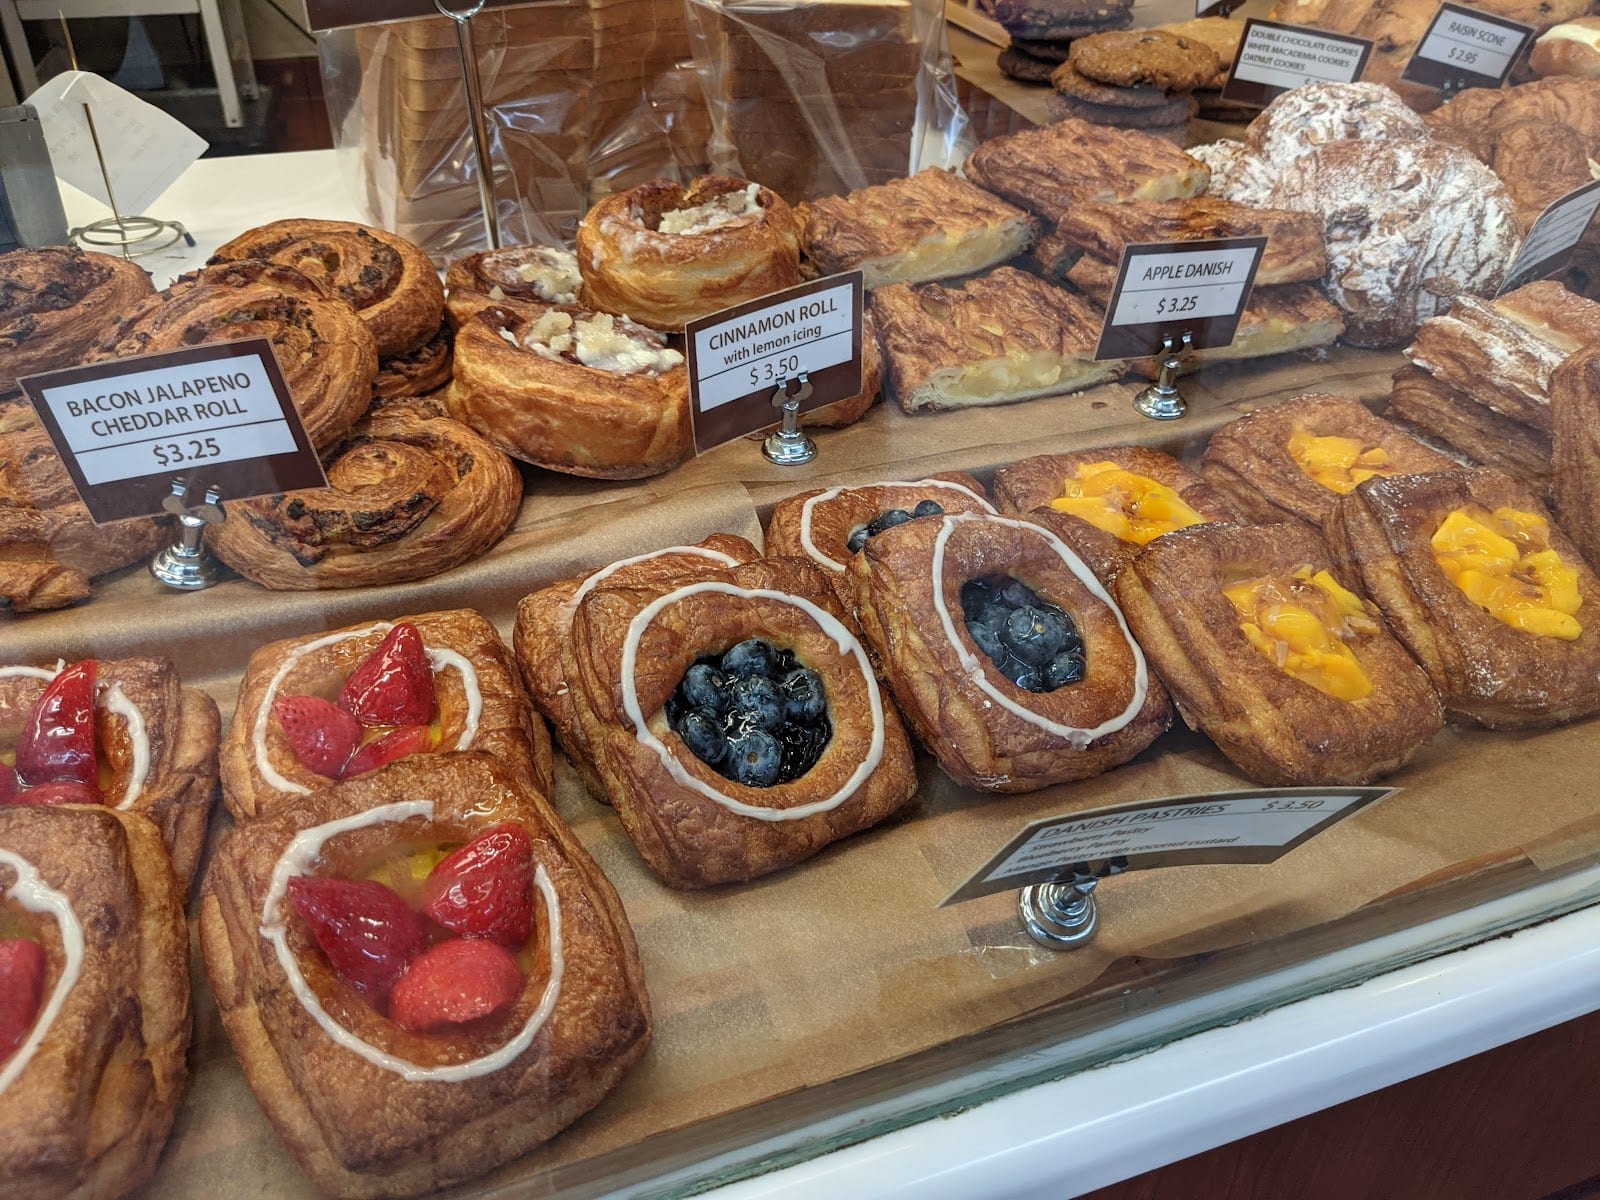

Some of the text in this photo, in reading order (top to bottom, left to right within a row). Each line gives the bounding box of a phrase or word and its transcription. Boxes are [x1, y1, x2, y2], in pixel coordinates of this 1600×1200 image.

[1250, 29, 1360, 57] DOUBLE CHOCOLATE COOKIES
[1448, 21, 1506, 47] RAISIN SCONE
[1243, 53, 1306, 71] OATNUT COOKIES
[1247, 42, 1350, 68] WHITE MACADEMIA COOKIES
[1142, 261, 1234, 281] APPLE DANISH
[1167, 296, 1198, 313] 3.25
[709, 297, 838, 351] CINNAMON ROLL
[724, 325, 822, 366] with lemon icing
[763, 355, 799, 381] 3.50
[66, 371, 252, 418] BACON JALAPENO
[91, 397, 248, 437] CHEDDAR ROLL
[152, 437, 222, 468] $3.25
[1279, 800, 1325, 810] 3.50
[1040, 804, 1230, 839] DANISH PASTRIES
[1111, 826, 1154, 837] Pastry
[1016, 839, 1131, 863] Blueberry Pastry
[1131, 840, 1189, 852] coconut
[1187, 836, 1240, 845] custard
